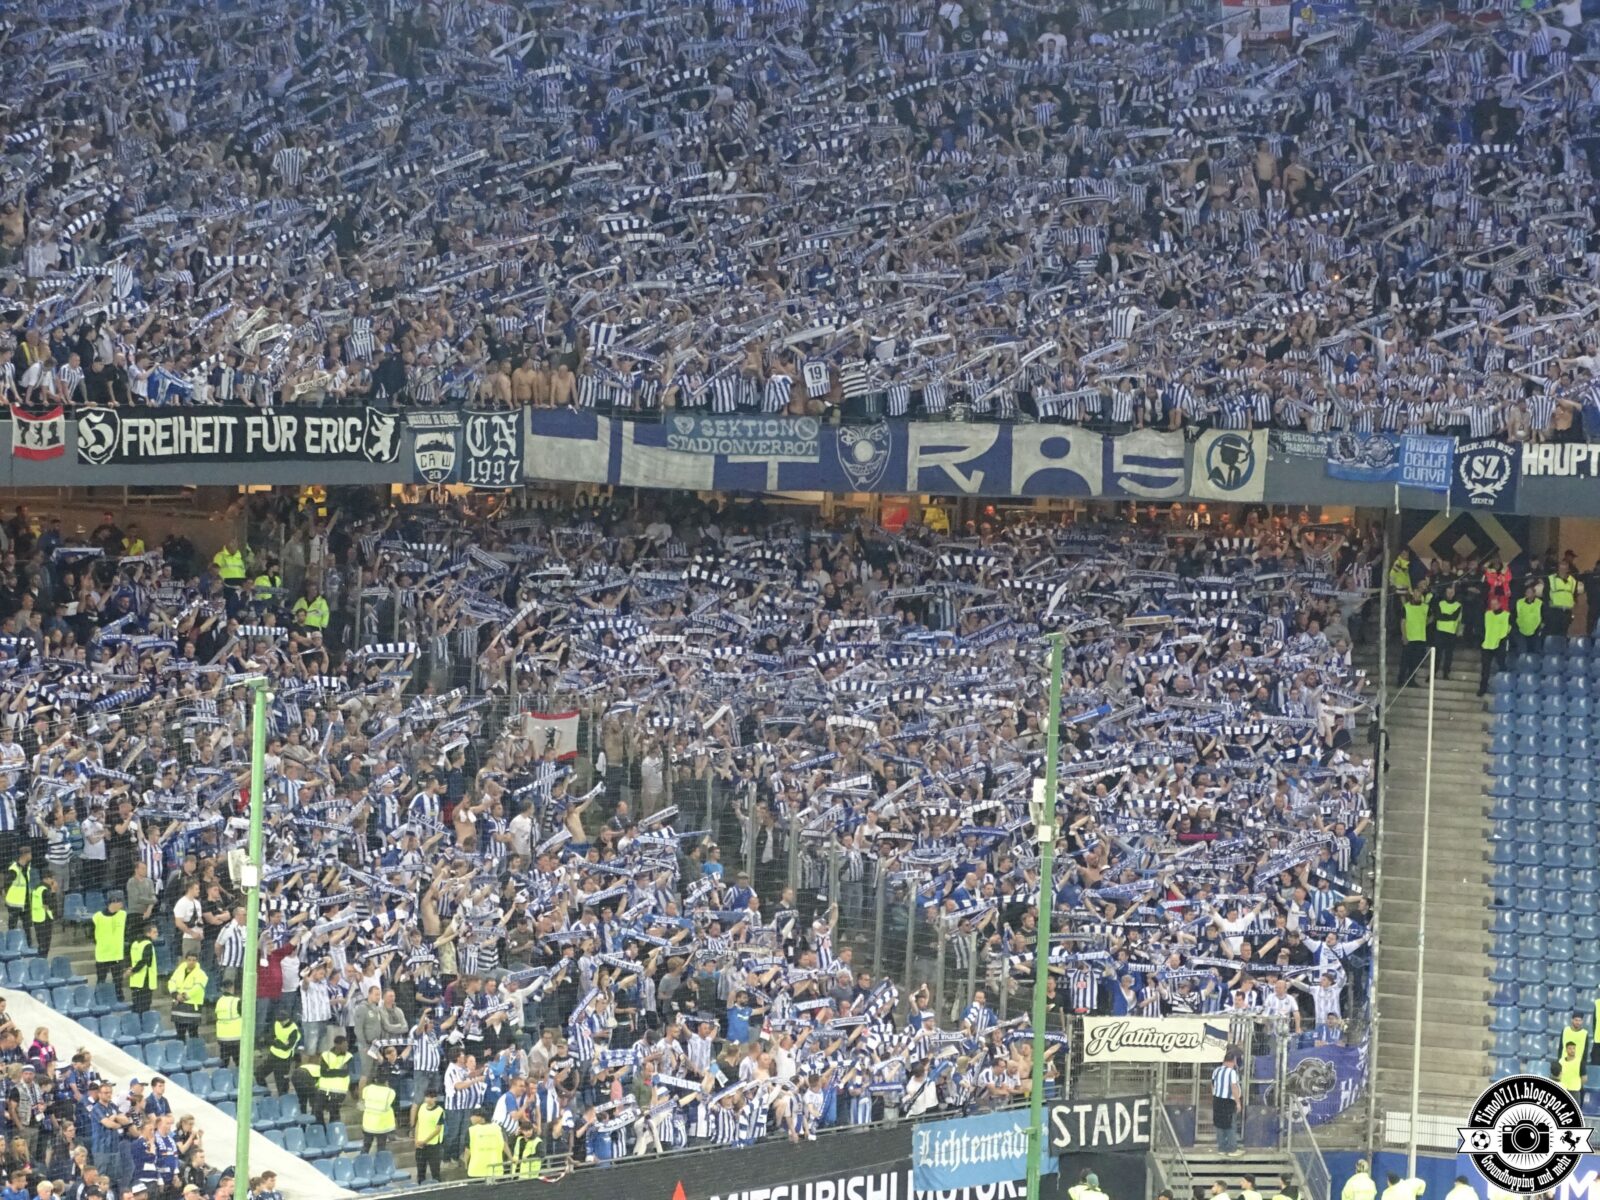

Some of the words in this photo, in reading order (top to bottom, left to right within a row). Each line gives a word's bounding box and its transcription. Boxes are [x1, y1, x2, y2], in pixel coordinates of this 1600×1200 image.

[121, 416, 238, 457] FREIHEIT
[244, 408, 298, 454] FÜR
[304, 416, 363, 455] ERIC
[700, 417, 795, 438] SEKTION
[667, 433, 819, 457] STADIONVERBOT
[468, 457, 520, 483] 1997
[1404, 452, 1447, 469] DELLA
[1471, 454, 1501, 480] SZ
[1085, 1021, 1200, 1057] Hattingen
[1051, 1100, 1149, 1149] STADE
[705, 1172, 898, 1200] BISHI
